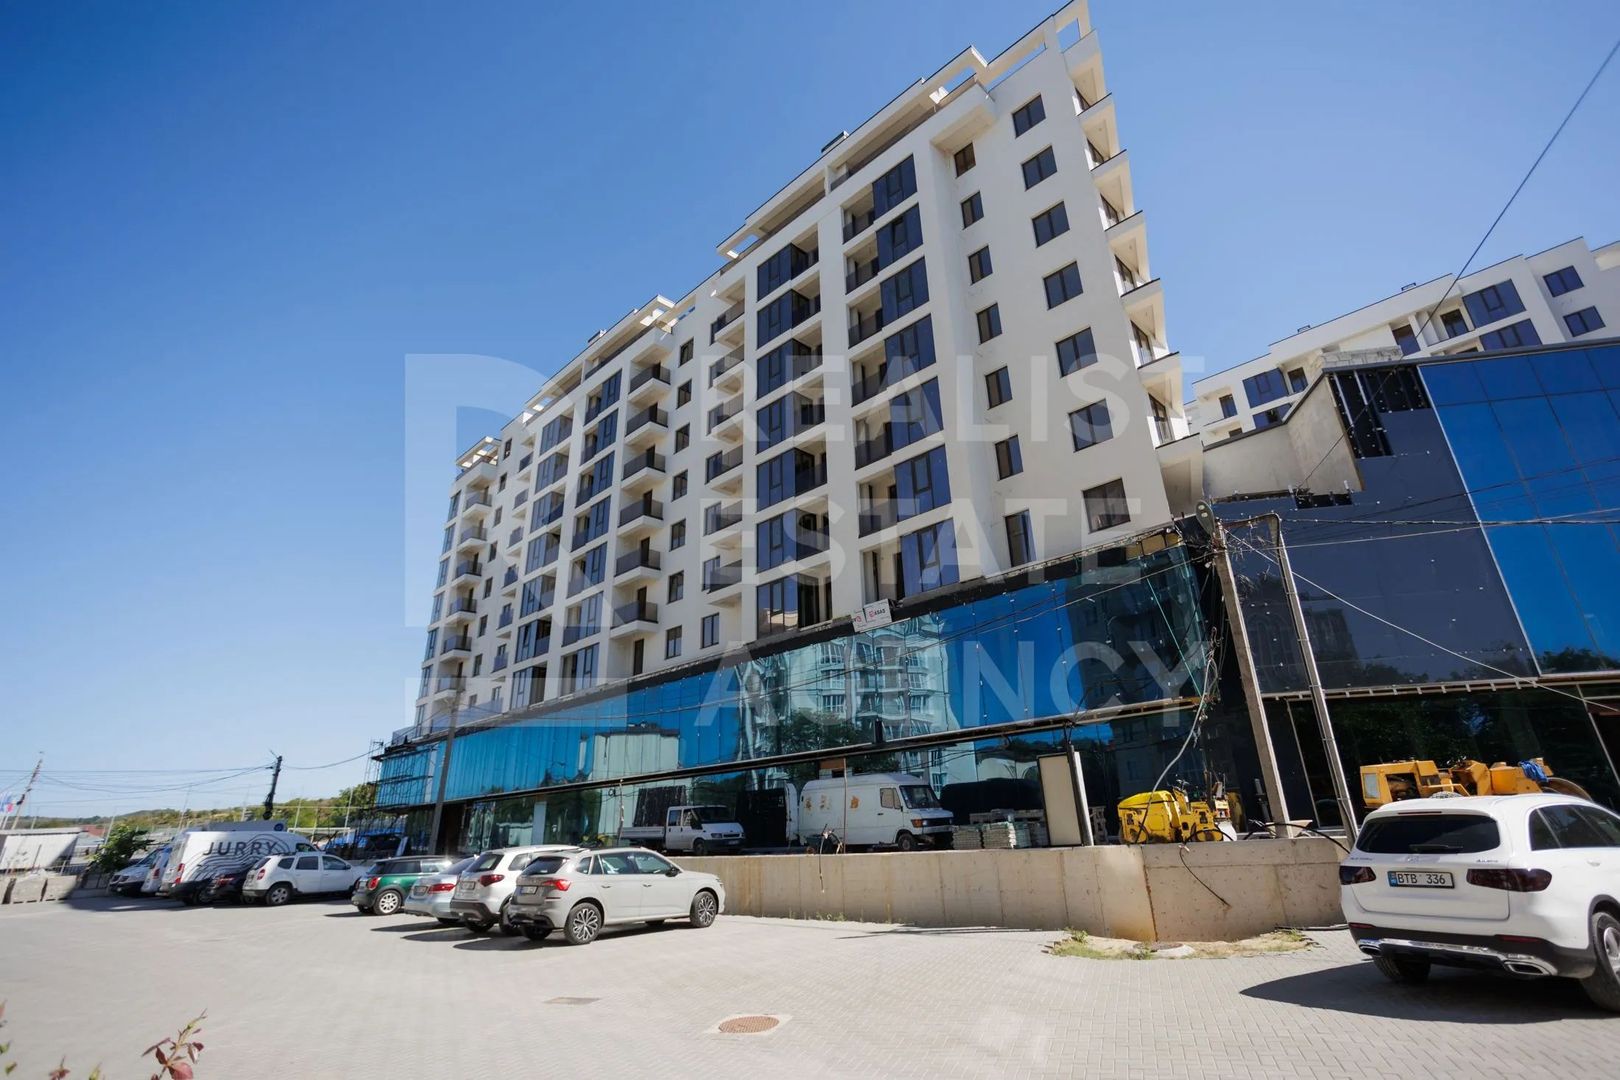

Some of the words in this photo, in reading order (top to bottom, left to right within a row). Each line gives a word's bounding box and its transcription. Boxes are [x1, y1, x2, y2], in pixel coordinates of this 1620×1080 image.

[203, 841, 278, 856] JURRY
[1397, 873, 1418, 884] BTB
[1426, 873, 1446, 885] 336
